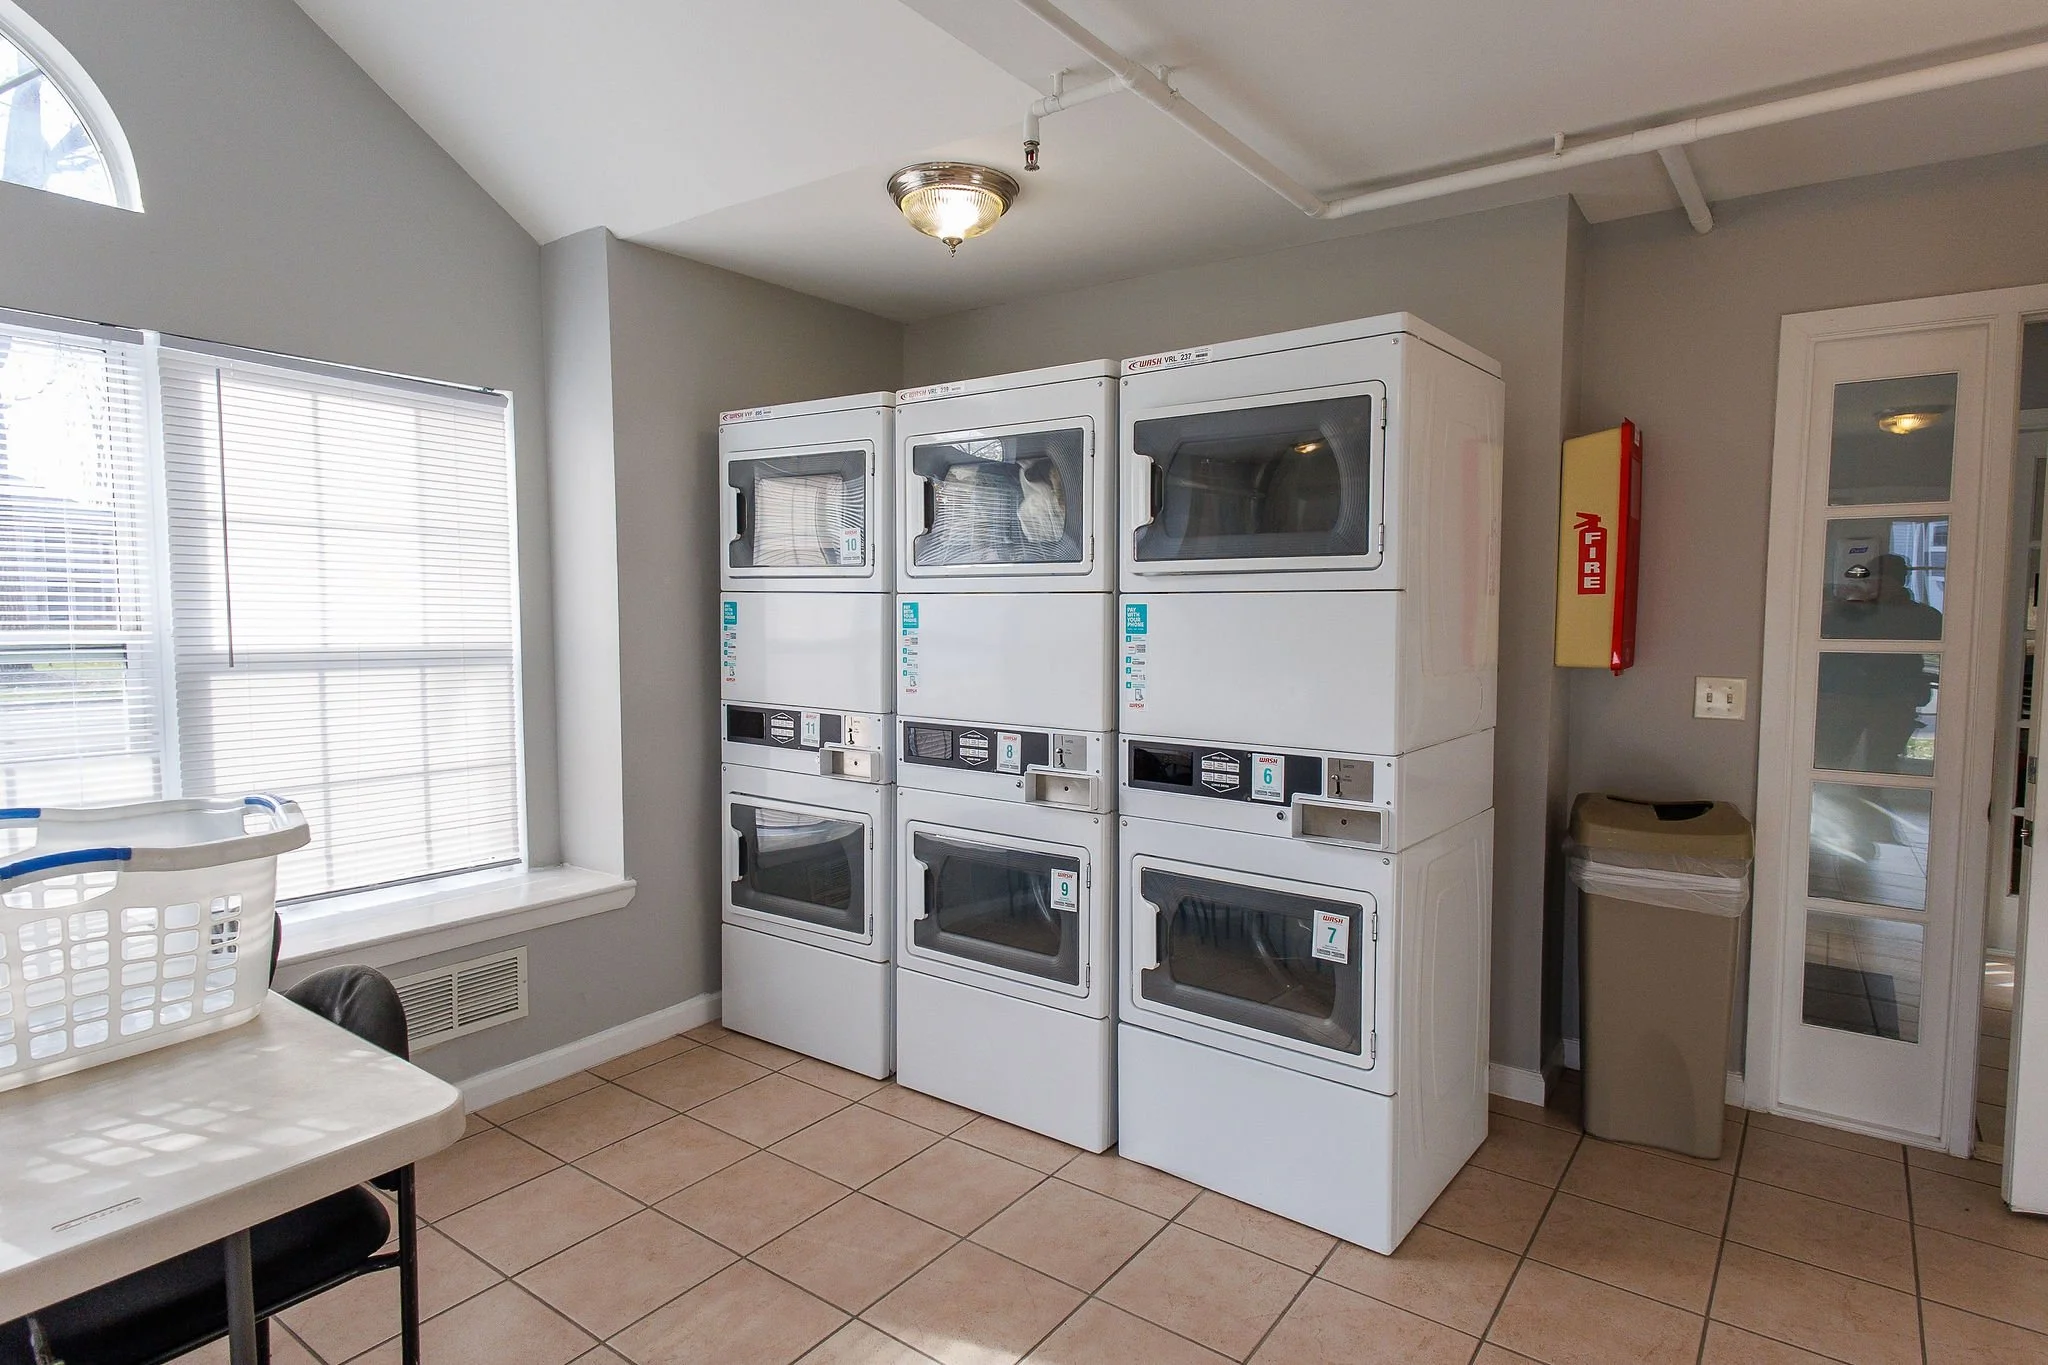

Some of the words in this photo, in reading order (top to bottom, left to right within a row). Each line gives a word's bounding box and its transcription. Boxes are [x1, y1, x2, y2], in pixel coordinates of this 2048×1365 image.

[1139, 357, 1162, 368] WASH
[1164, 355, 1177, 363] VRL
[1180, 353, 1192, 361] 237
[845, 538, 857, 551] 10
[1583, 532, 1601, 589] FIRE
[805, 721, 815, 735] 11
[1006, 744, 1013, 759] 8
[1263, 767, 1273, 785] 6
[1061, 881, 1069, 896] 9
[1322, 915, 1344, 924] WASH
[1327, 926, 1337, 944] 7
